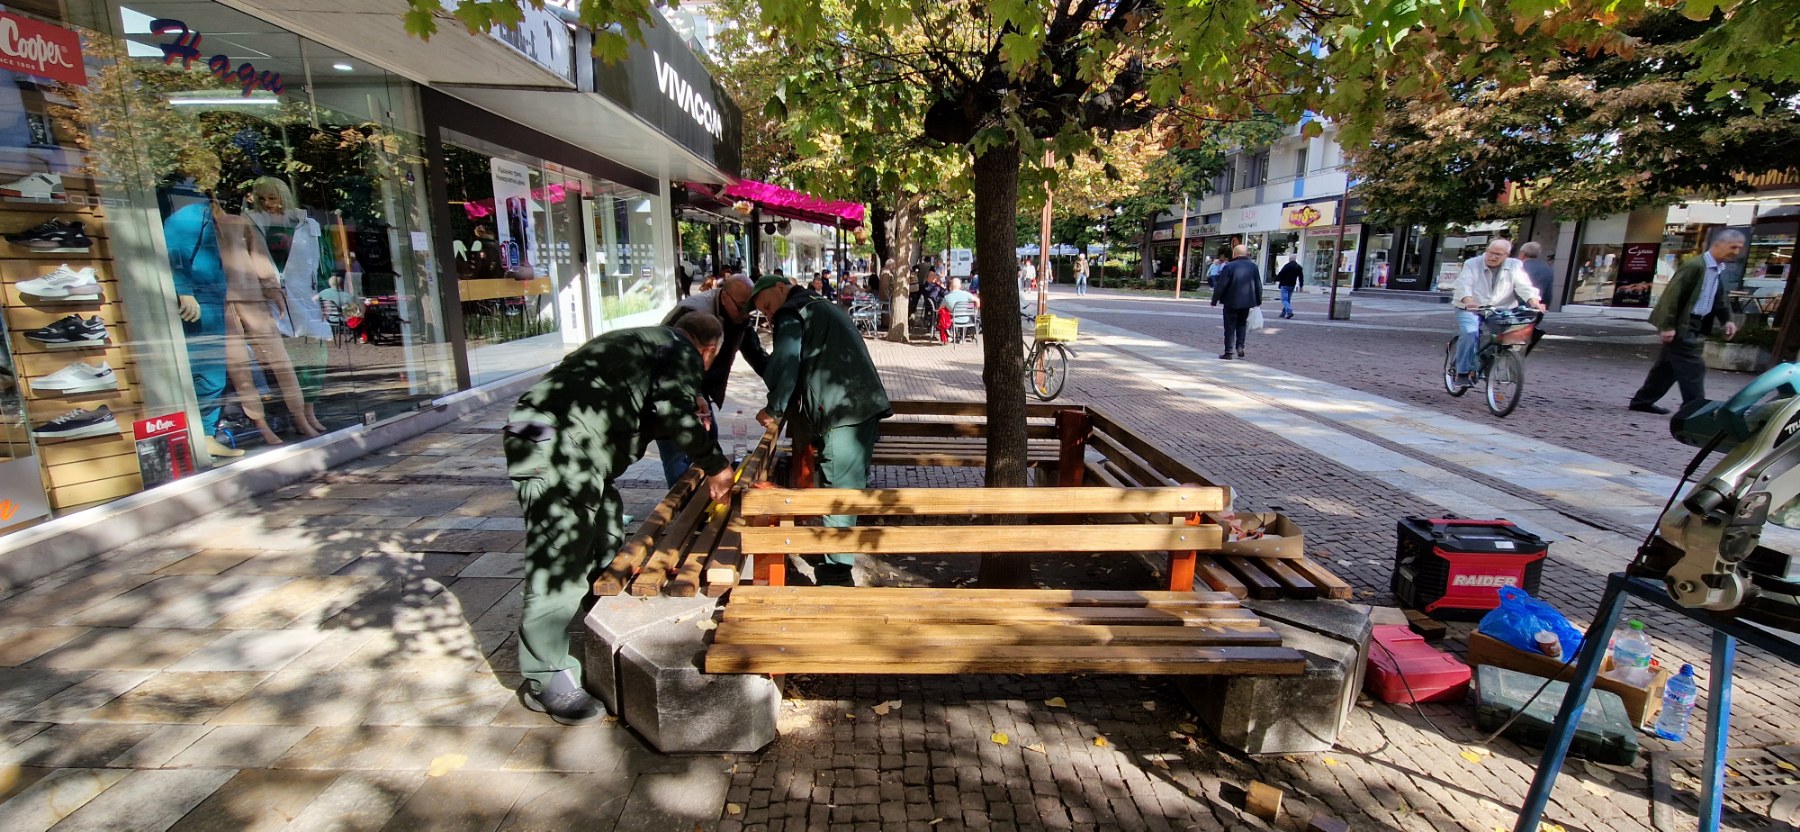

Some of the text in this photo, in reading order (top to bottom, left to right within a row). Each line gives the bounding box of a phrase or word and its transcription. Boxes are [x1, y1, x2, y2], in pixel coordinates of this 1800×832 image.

[0, 16, 74, 72] Cooper
[653, 49, 723, 142] VIVACOM
[1452, 574, 1518, 588] RAIDER
